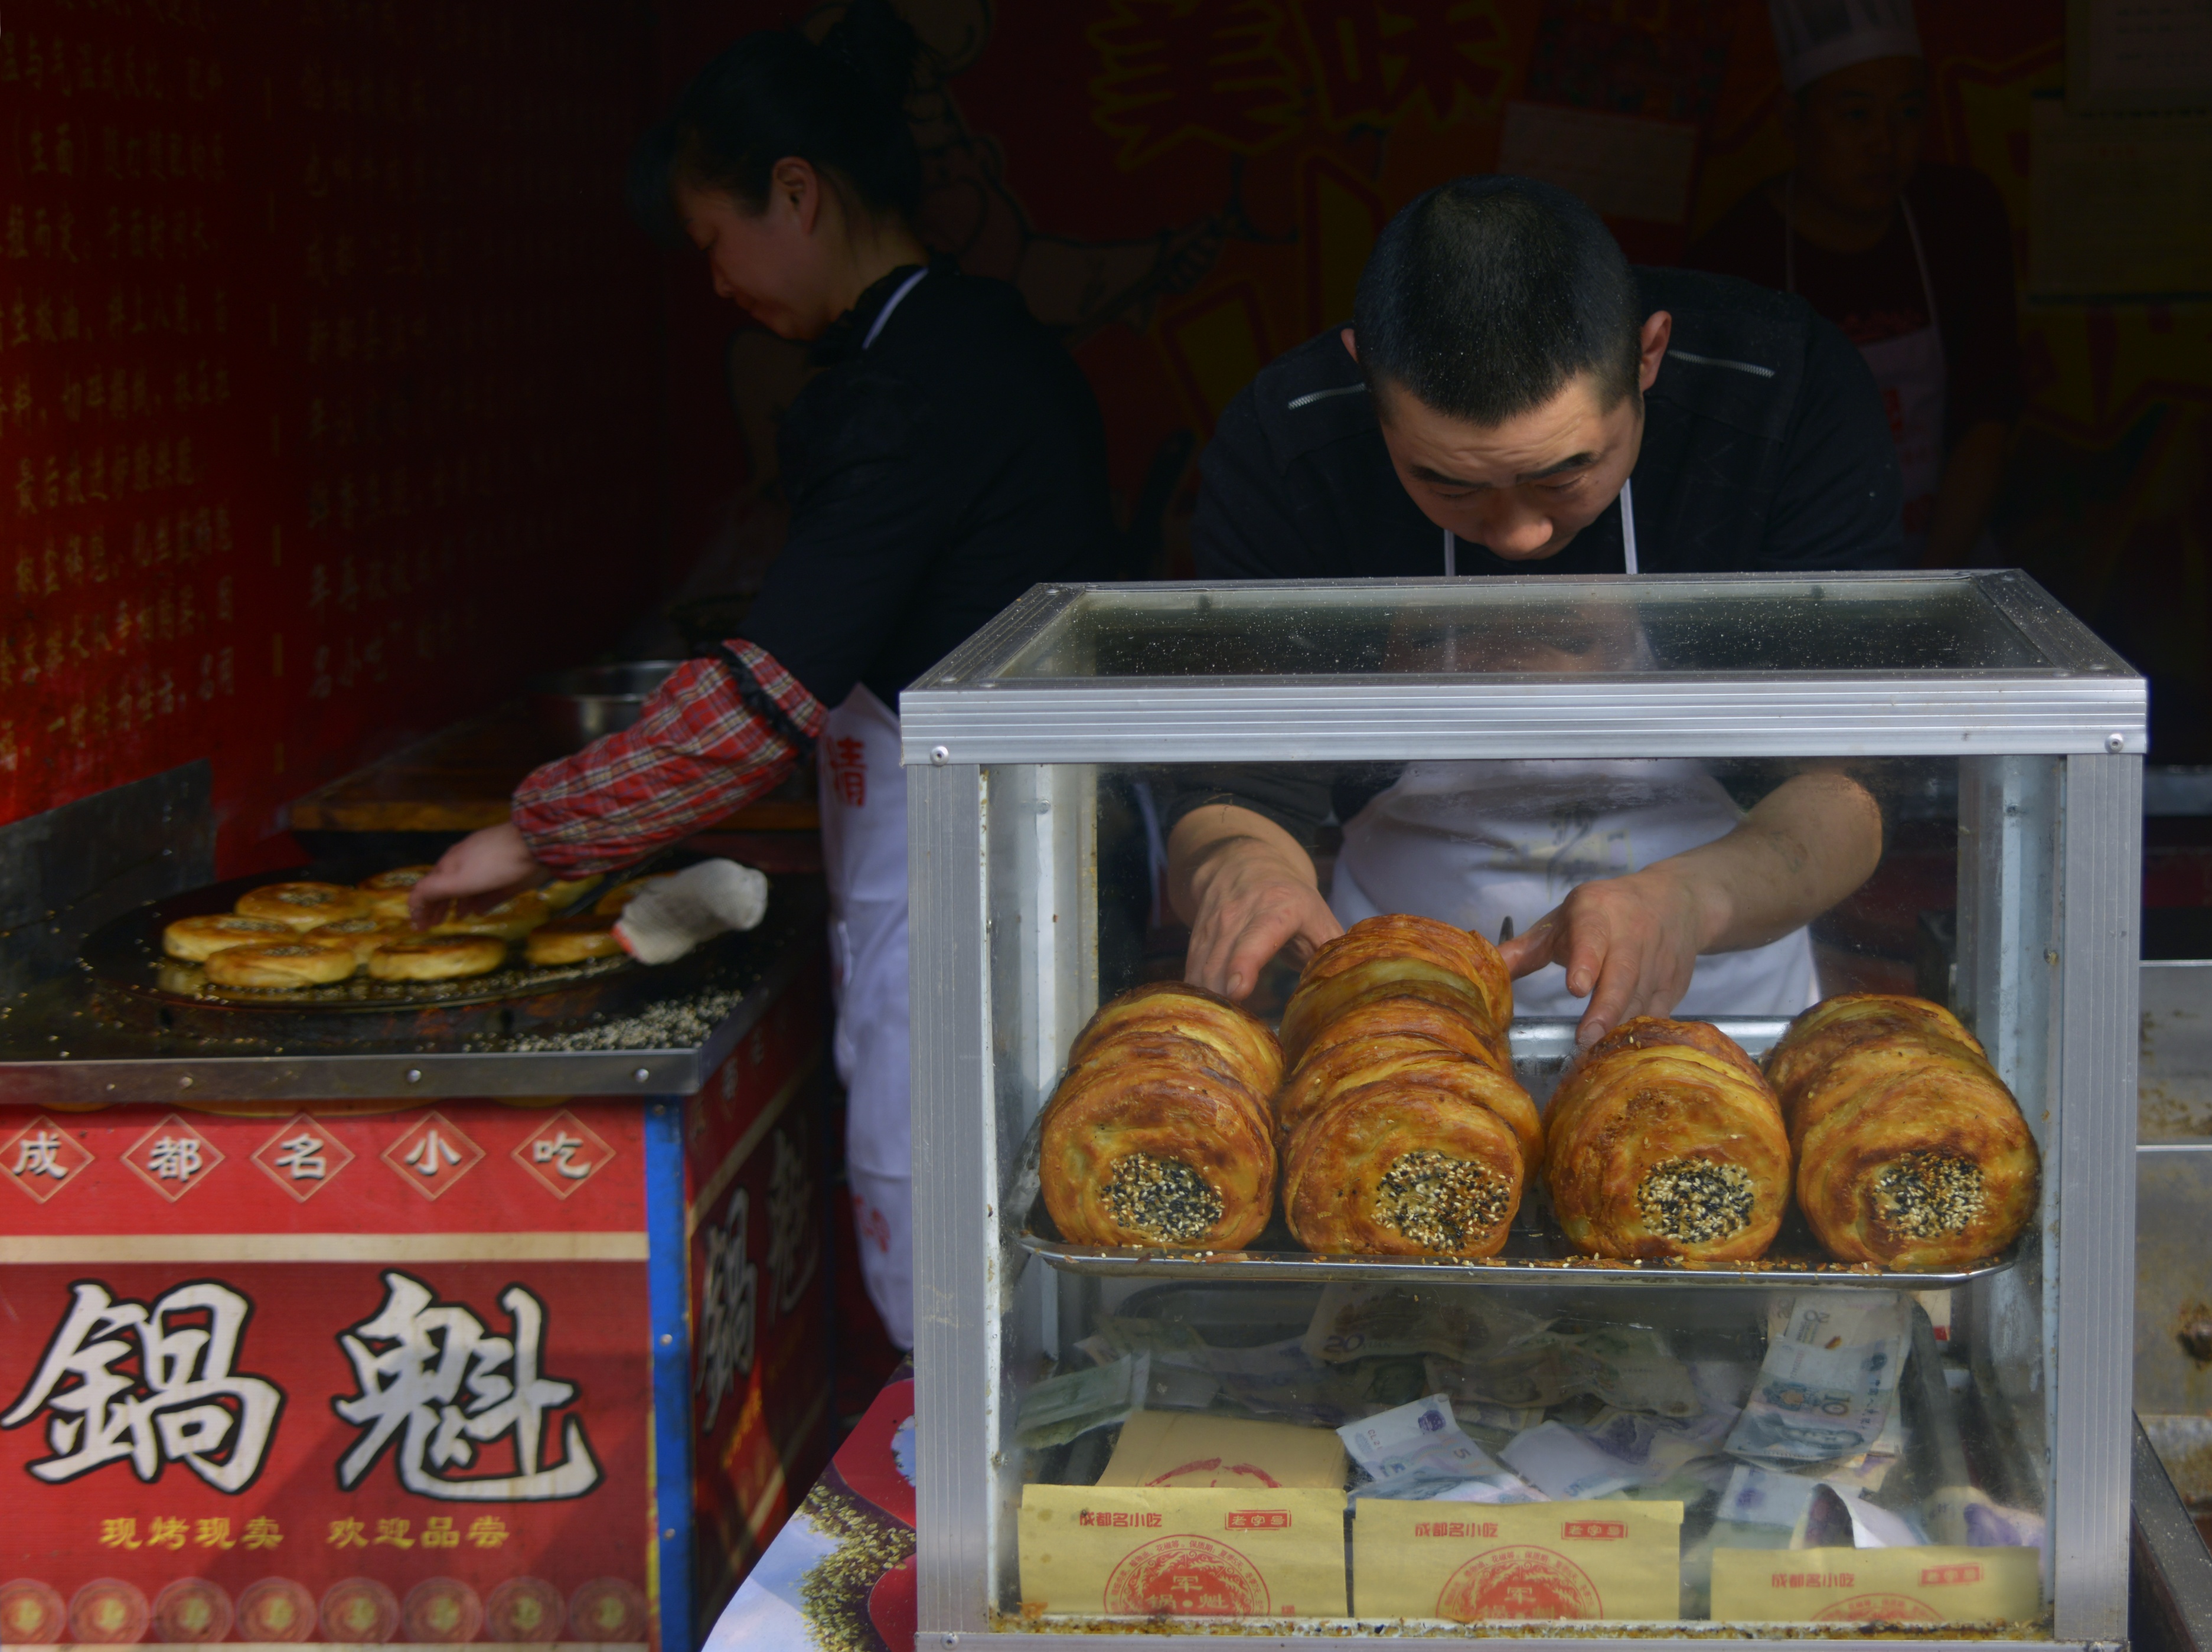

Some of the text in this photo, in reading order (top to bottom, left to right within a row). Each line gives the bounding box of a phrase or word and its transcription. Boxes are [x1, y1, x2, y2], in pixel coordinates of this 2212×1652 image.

[11, 1128, 592, 1182] 成都名小吃
[1079, 1511, 1163, 1528] 成都名小吃
[1231, 1514, 1286, 1527] 老字号
[100, 1515, 511, 1551] 现烤现卖 欢迎品尝
[1415, 1523, 1499, 1539] 成都名小吃
[1771, 1573, 1855, 1589] 成都名小吃
